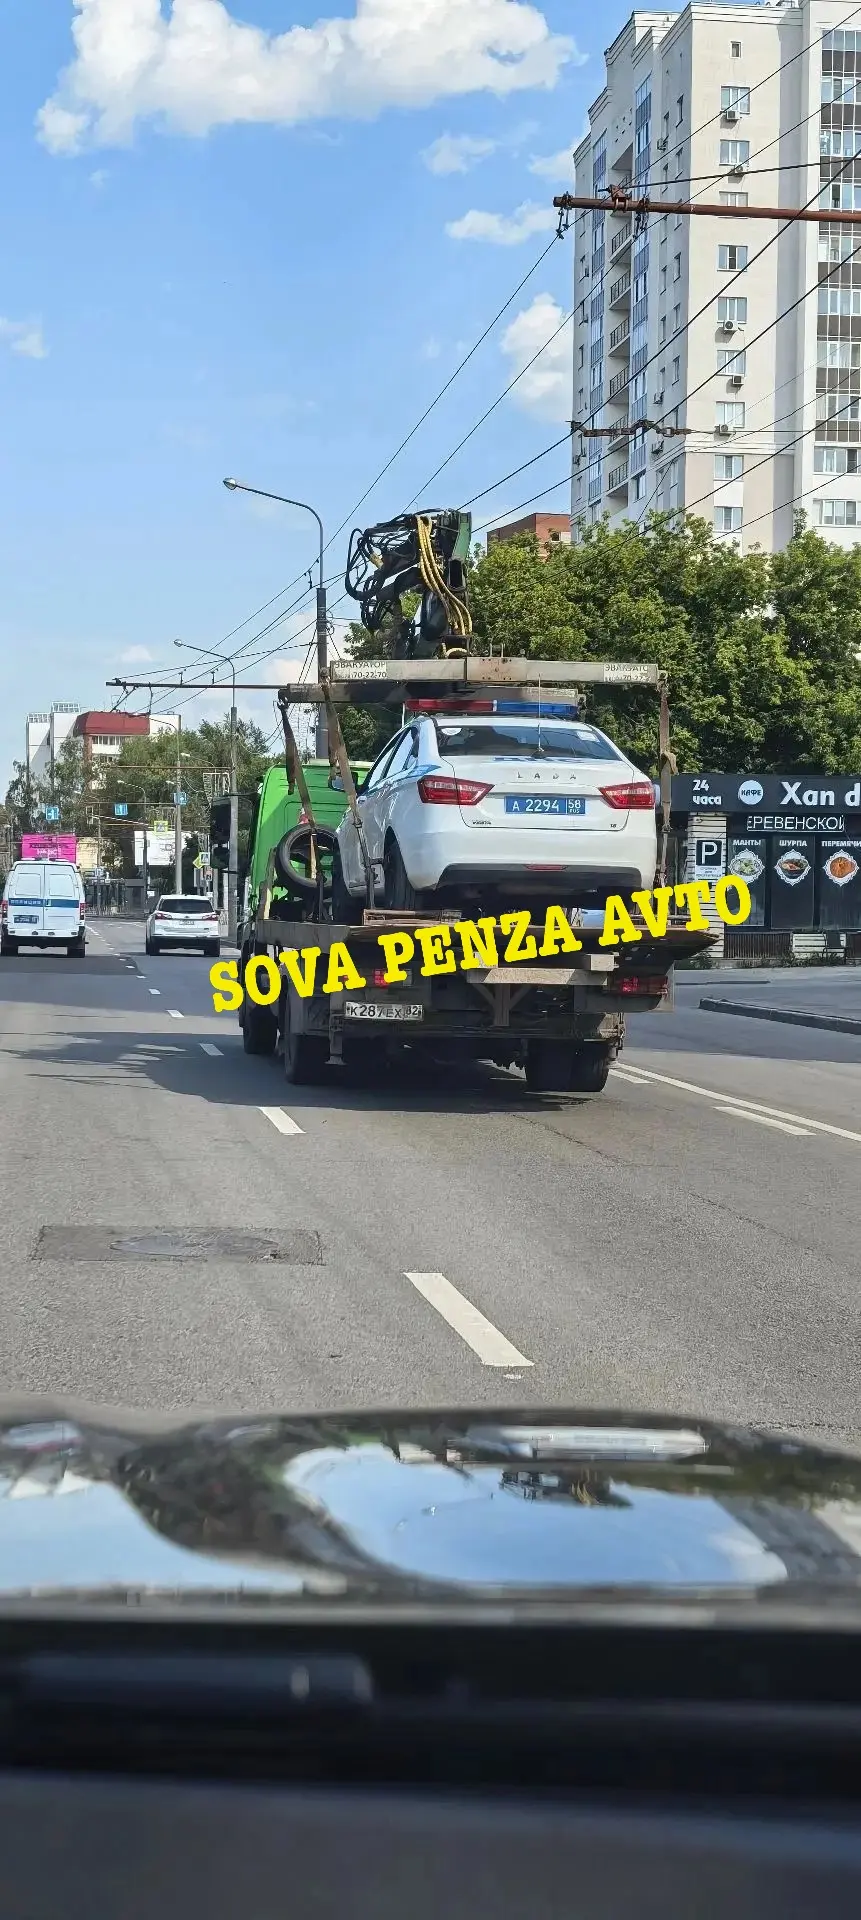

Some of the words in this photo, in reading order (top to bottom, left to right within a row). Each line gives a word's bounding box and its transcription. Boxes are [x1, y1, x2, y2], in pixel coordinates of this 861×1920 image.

[334, 660, 386, 669] ЭВАКУАТОР
[517, 771, 577, 780] LADA
[692, 779, 710, 791] 24
[780, 781, 835, 806] Xan
[568, 799, 582, 809] 58
[692, 795, 722, 805] часа
[512, 800, 520, 812] А
[525, 799, 560, 812] 2294
[779, 839, 808, 847] ШУРПА
[701, 841, 718, 865] P
